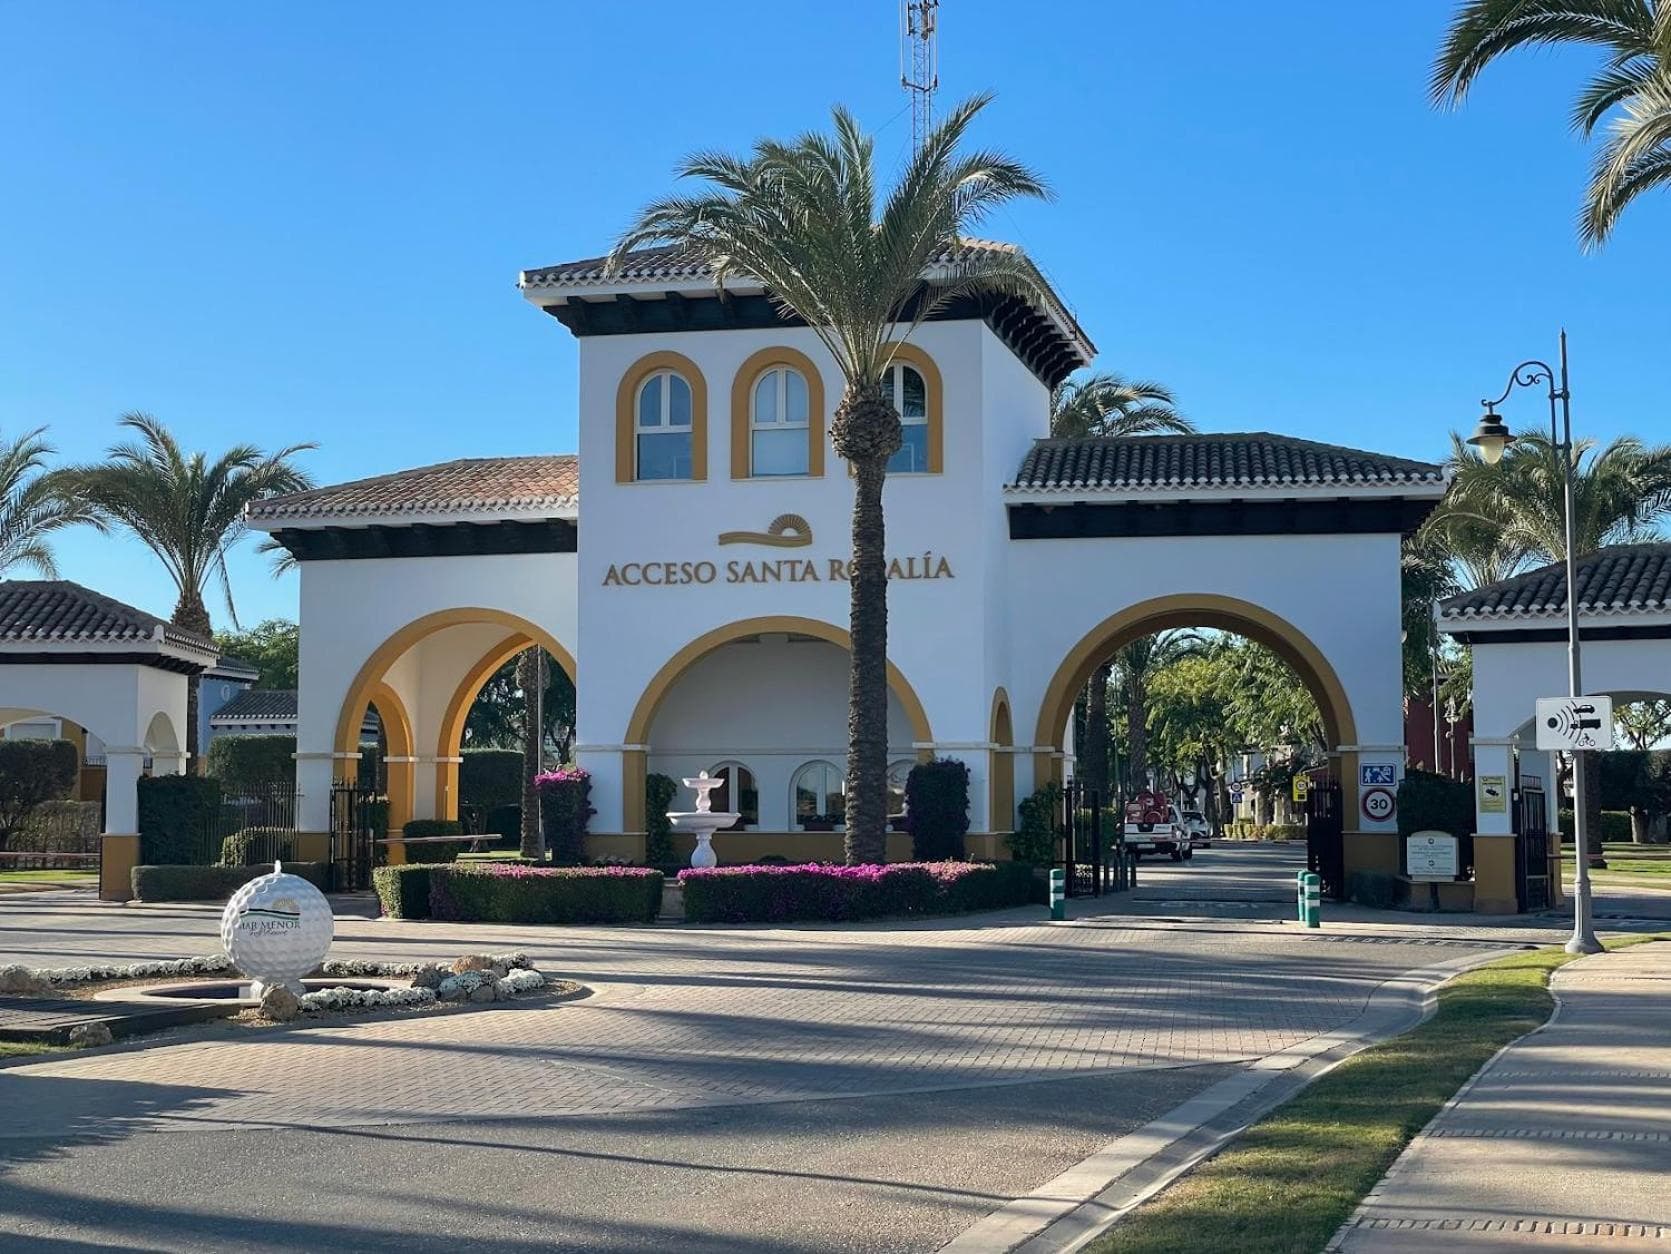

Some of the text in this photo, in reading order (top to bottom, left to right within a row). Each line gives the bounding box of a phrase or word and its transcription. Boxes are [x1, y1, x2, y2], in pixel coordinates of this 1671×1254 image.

[602, 550, 955, 586] ACCESO SANTA RALÍA
[1370, 798, 1388, 810] 30
[261, 920, 301, 930] MENOR
